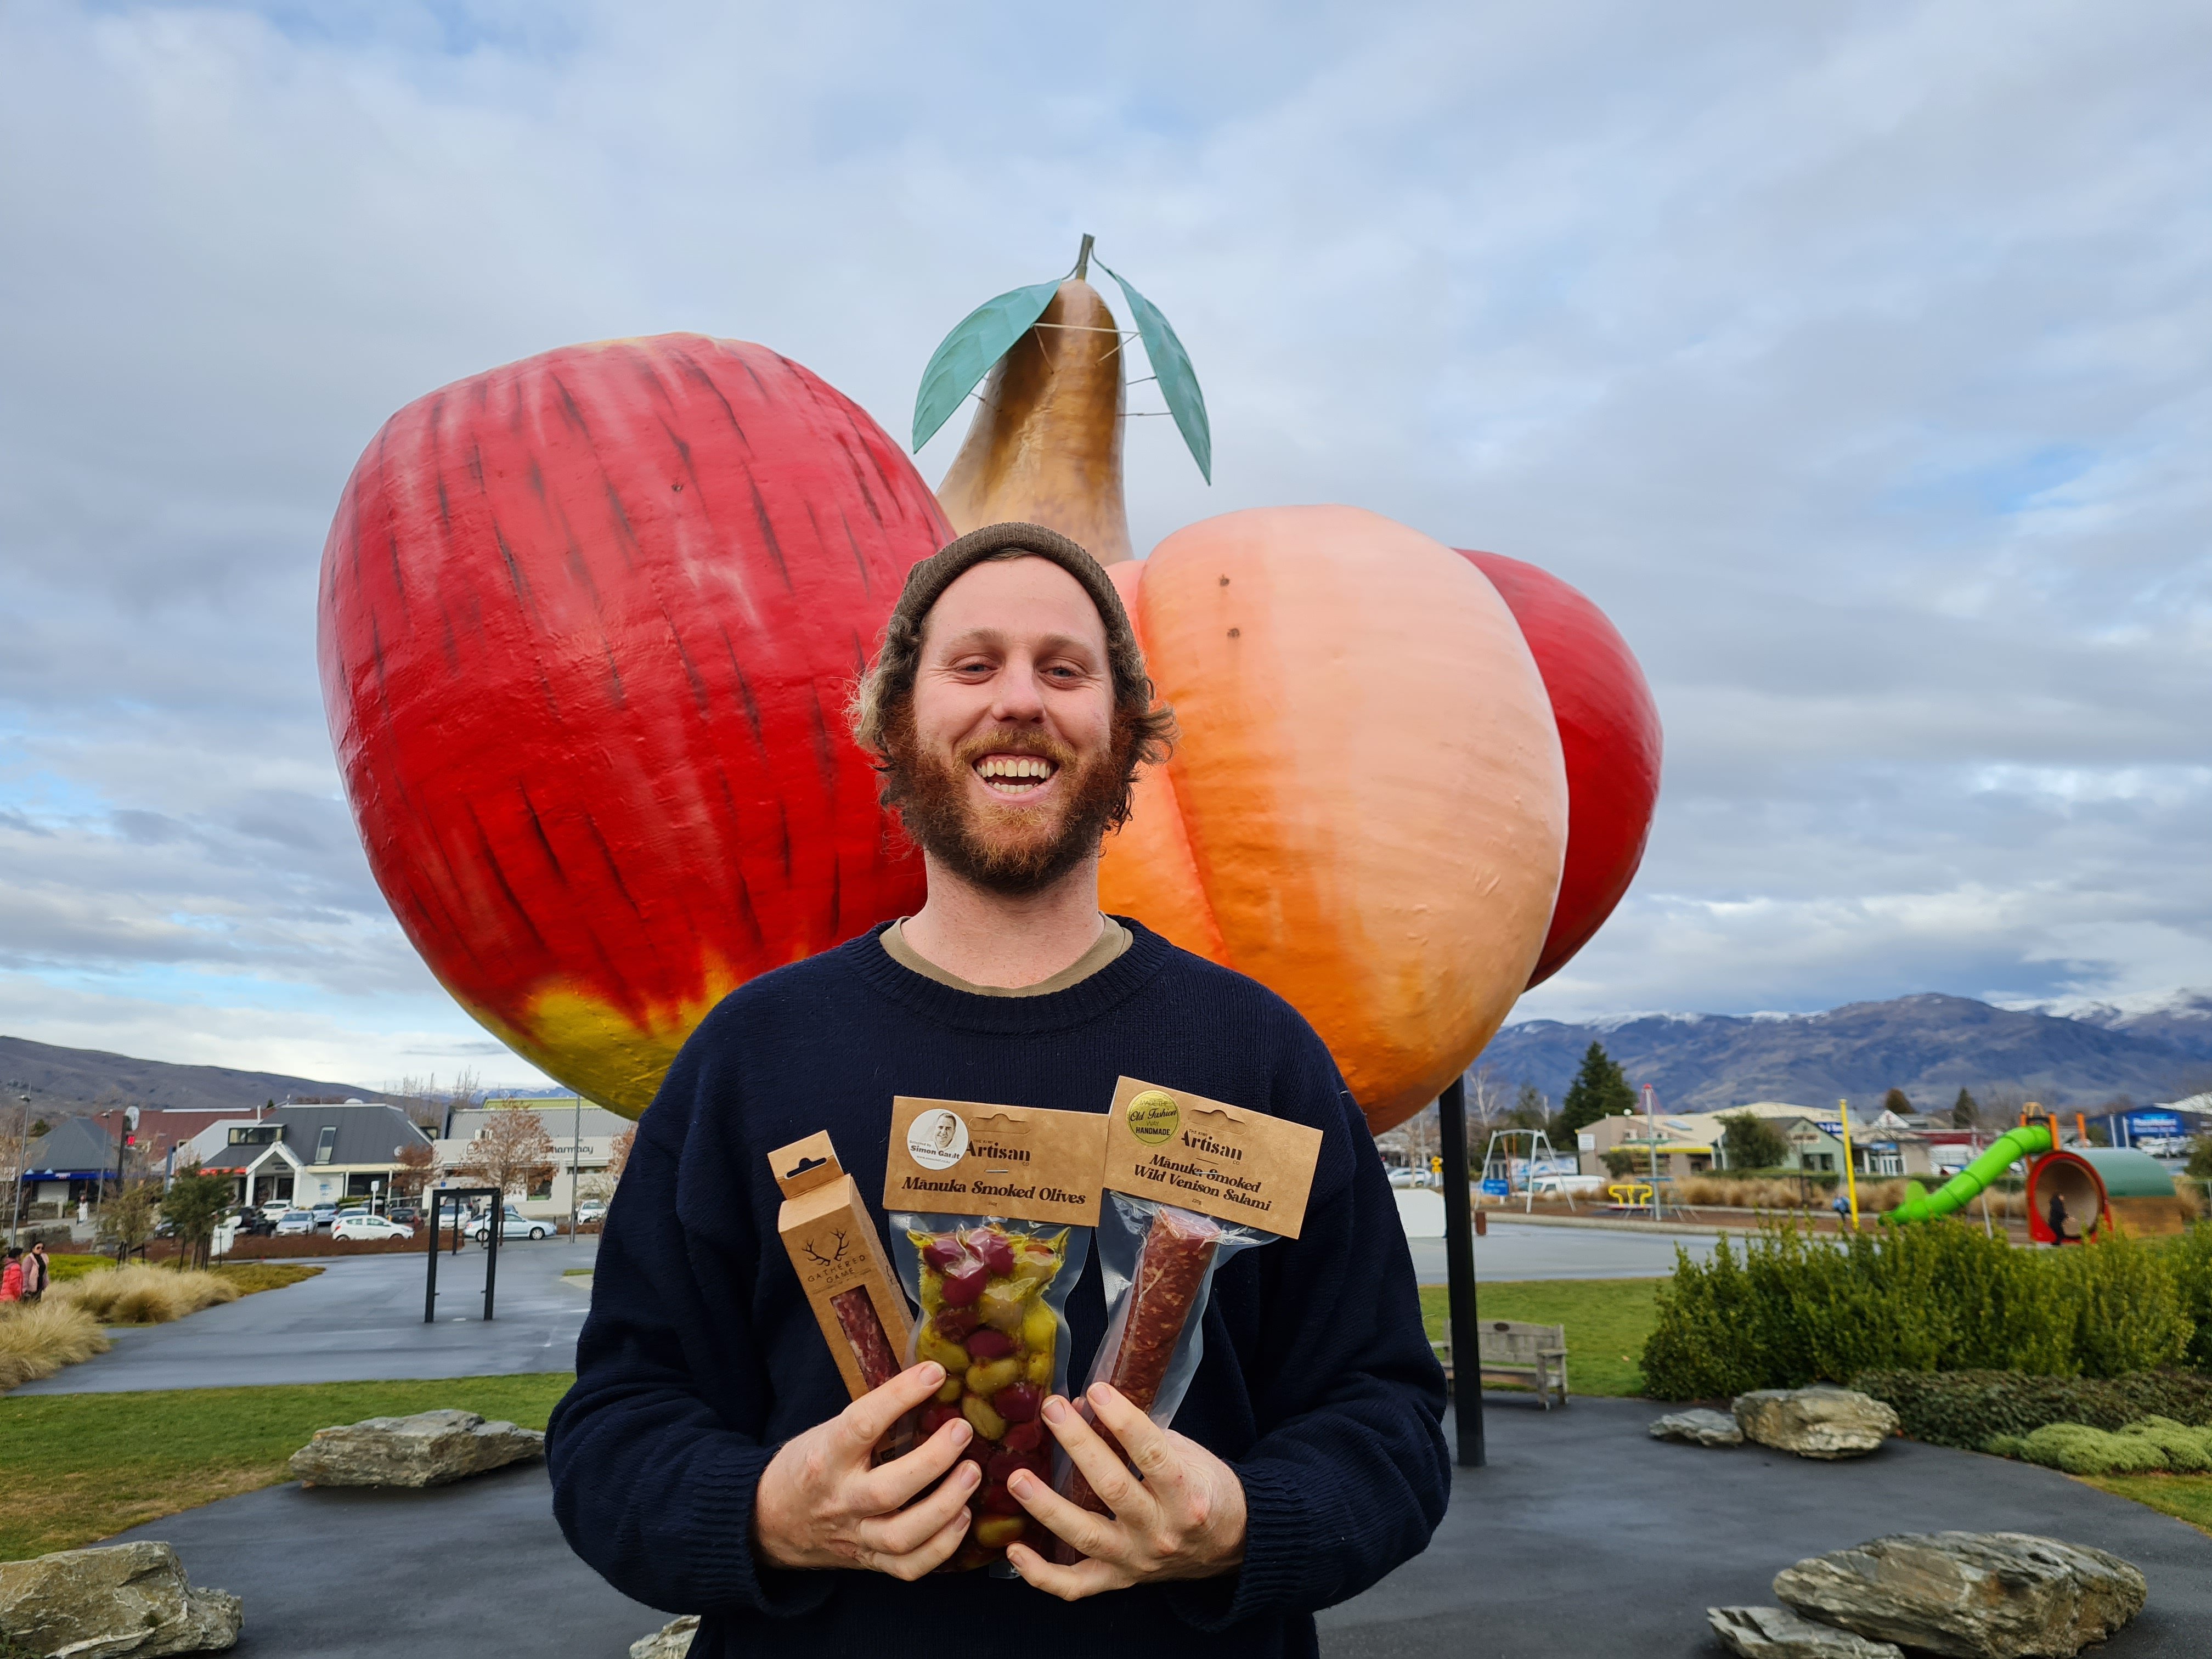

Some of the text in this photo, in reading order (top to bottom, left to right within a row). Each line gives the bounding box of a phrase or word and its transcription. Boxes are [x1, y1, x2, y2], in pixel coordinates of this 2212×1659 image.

[1130, 1108, 1178, 1122] Old Fashion
[1136, 1127, 1171, 1136] HANDMADE
[910, 1145, 960, 1159] Simon Gault
[966, 1140, 1030, 1161] Artisan
[1181, 1130, 1242, 1160] Artisan
[1149, 1154, 1261, 1193] Mānuka Smoked
[901, 1176, 1086, 1204] Mānuka Smoked Olives
[1134, 1164, 1272, 1211] Wild Venison Salami
[808, 1255, 865, 1282] GATHERED
[826, 1267, 855, 1283] GAME
